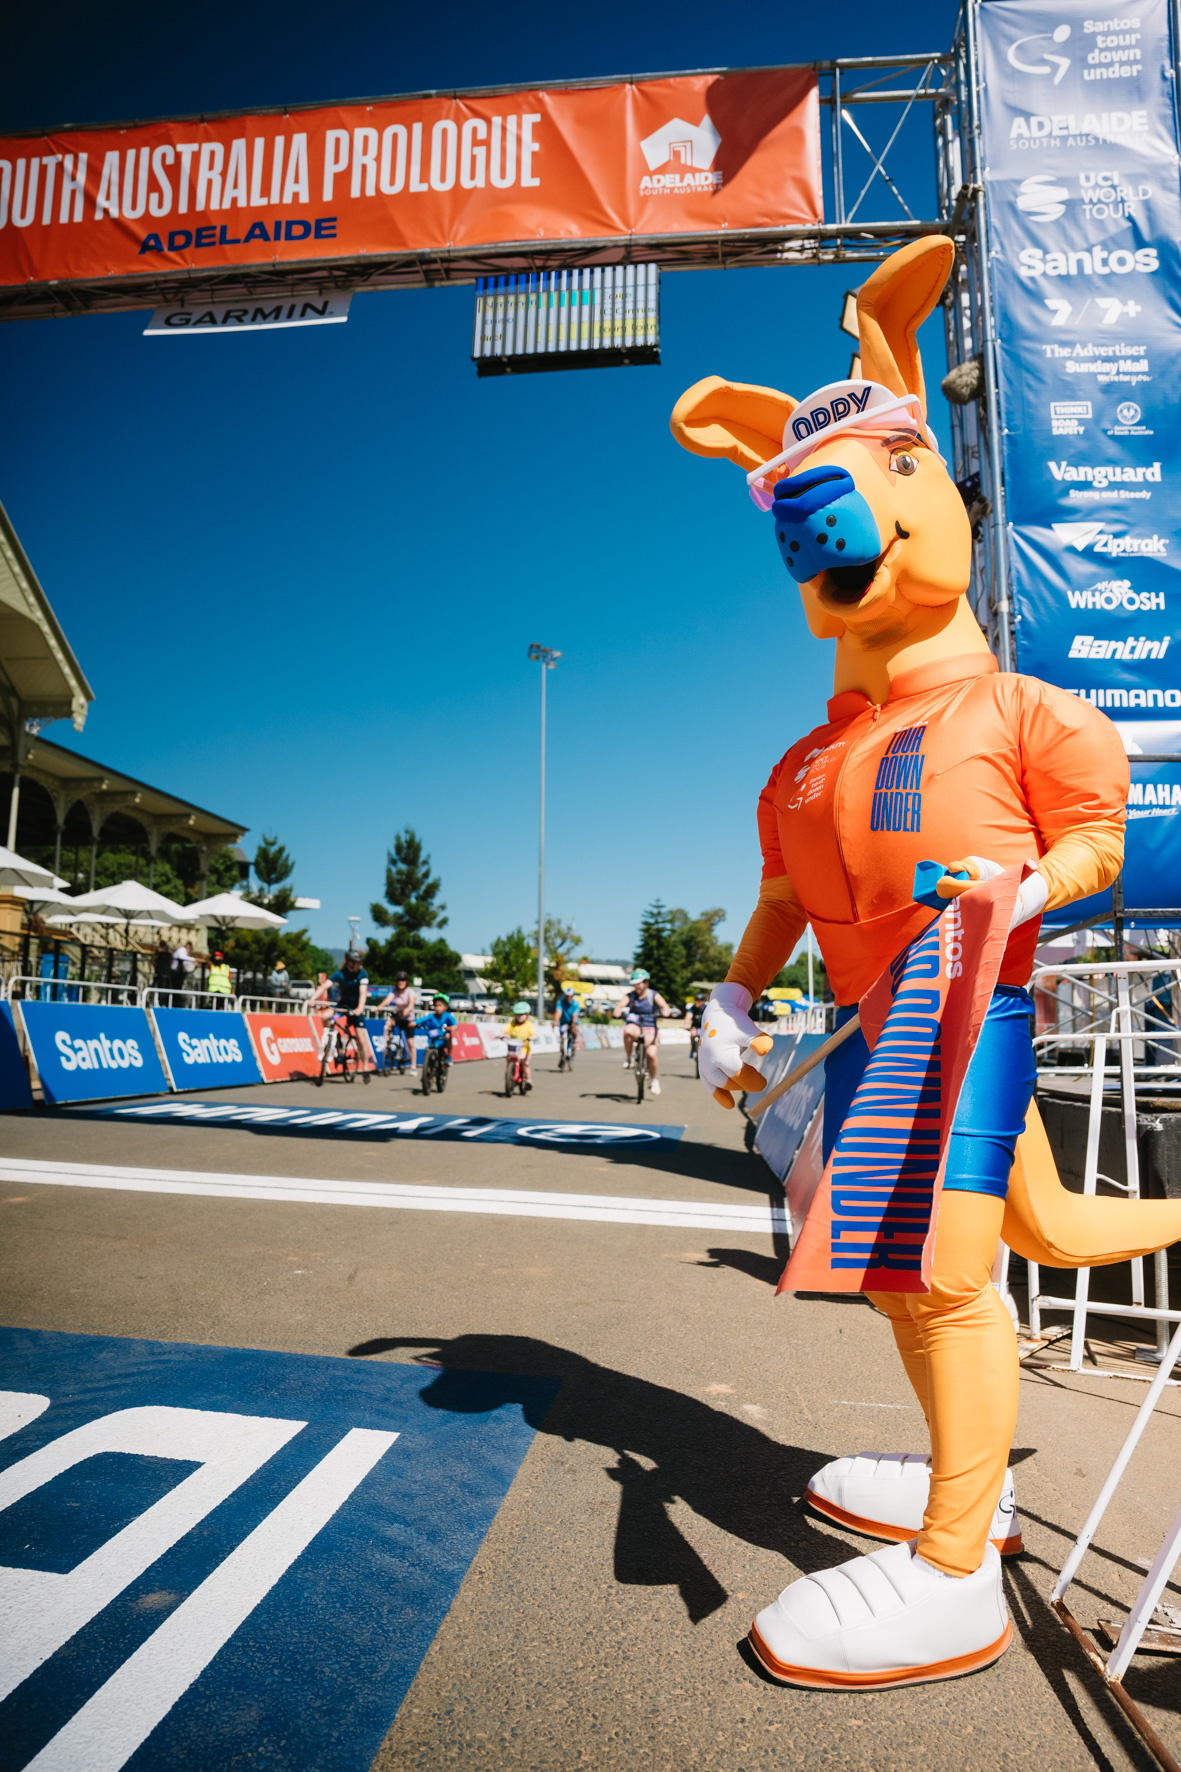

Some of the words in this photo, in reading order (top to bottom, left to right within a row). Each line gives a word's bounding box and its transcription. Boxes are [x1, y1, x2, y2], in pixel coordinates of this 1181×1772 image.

[1083, 18, 1141, 34] Santos
[1096, 33, 1141, 48] tour
[1087, 49, 1141, 65] down
[1083, 63, 1142, 81] under
[1009, 110, 1149, 139] ADELAIDE
[1009, 137, 1061, 150] SOUTH
[1066, 132, 1150, 147] AUSTRALIA
[94, 132, 310, 221] AUSTRALIA
[323, 113, 542, 202] PROLOGUE
[640, 171, 723, 189] ADELAIDE
[1079, 171, 1120, 187] UCI
[640, 188, 671, 196] SOUTH
[1080, 185, 1153, 204] WORLD
[1082, 203, 1137, 220] TOUR
[138, 217, 338, 255] ADELAIDE
[1019, 246, 1160, 277] Santos
[164, 301, 329, 327] GARMIN
[1043, 298, 1073, 326] 7
[1042, 344, 1072, 357] The
[1072, 343, 1147, 357] Advertiser
[1065, 359, 1118, 375] Sunday
[1118, 358, 1149, 372] Mail
[792, 386, 872, 441] OPPY
[1051, 419, 1079, 427] ROAD
[1052, 426, 1085, 435] SAFETY
[1047, 461, 1162, 488] Vanguard
[1069, 489, 1100, 500] Strong
[1101, 489, 1118, 499] and
[1119, 489, 1152, 500] Steady
[1093, 534, 1168, 557] Ziptrak
[1068, 635, 1171, 660] Santini
[1067, 689, 1181, 708] HIMANO
[884, 725, 927, 756] TOUR
[875, 755, 925, 791] DOWN
[870, 792, 921, 832] UNDER
[54, 1031, 144, 1071] Santos
[177, 1031, 243, 1064] Santos
[830, 1127, 941, 1271] UNDER
